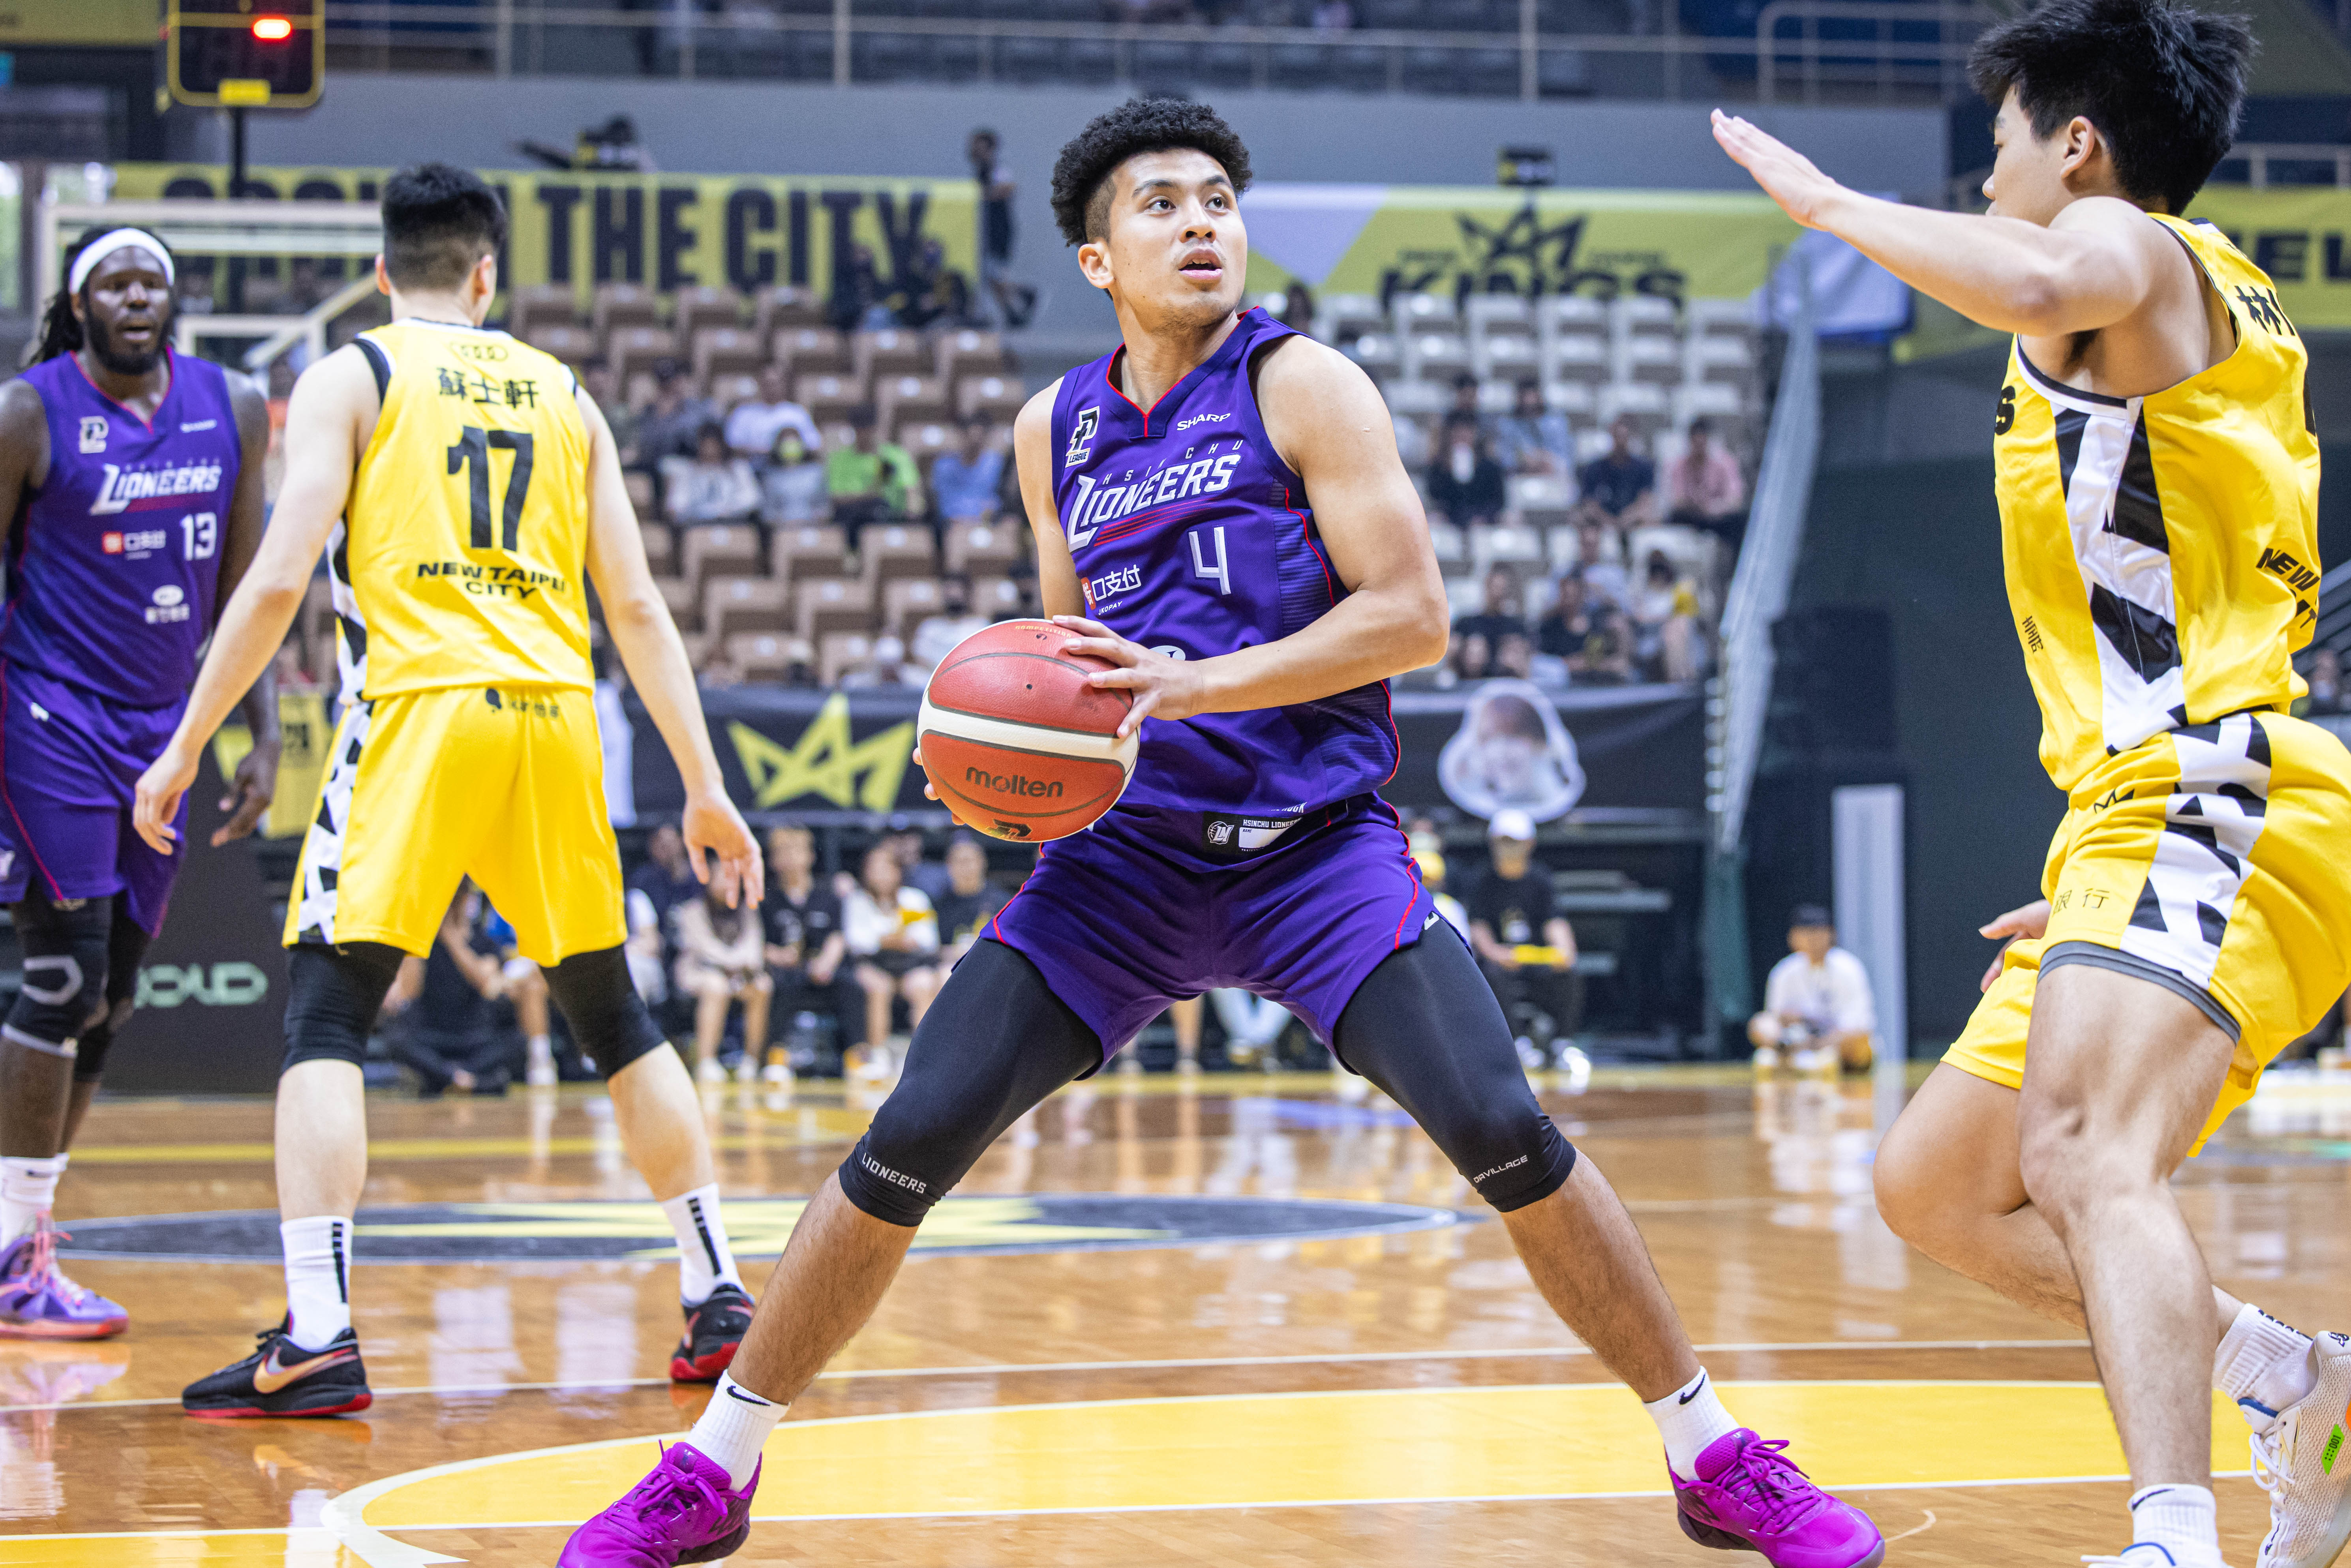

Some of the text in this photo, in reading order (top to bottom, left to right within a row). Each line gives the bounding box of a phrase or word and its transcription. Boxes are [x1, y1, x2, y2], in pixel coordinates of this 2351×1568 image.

[536, 186, 698, 291] THE
[727, 188, 931, 293] CITY
[1176, 413, 1231, 431] SHARP
[1069, 451, 1088, 463] LEAGUE
[90, 463, 222, 515] LIONEERS
[447, 425, 533, 552] 17
[1068, 454, 1241, 553] LIONEERS
[180, 512, 217, 561] 13
[418, 562, 482, 578] NEW
[1188, 527, 1231, 595] 4
[2255, 548, 2320, 592] NEW
[466, 581, 537, 599] CITY
[1098, 601, 1122, 615] JKOPAY
[966, 767, 1063, 797] molten
[1243, 819, 1269, 828] HSINCHU
[862, 1152, 927, 1194] LIONEERS
[1473, 1155, 1528, 1183] DAVILLAGE
